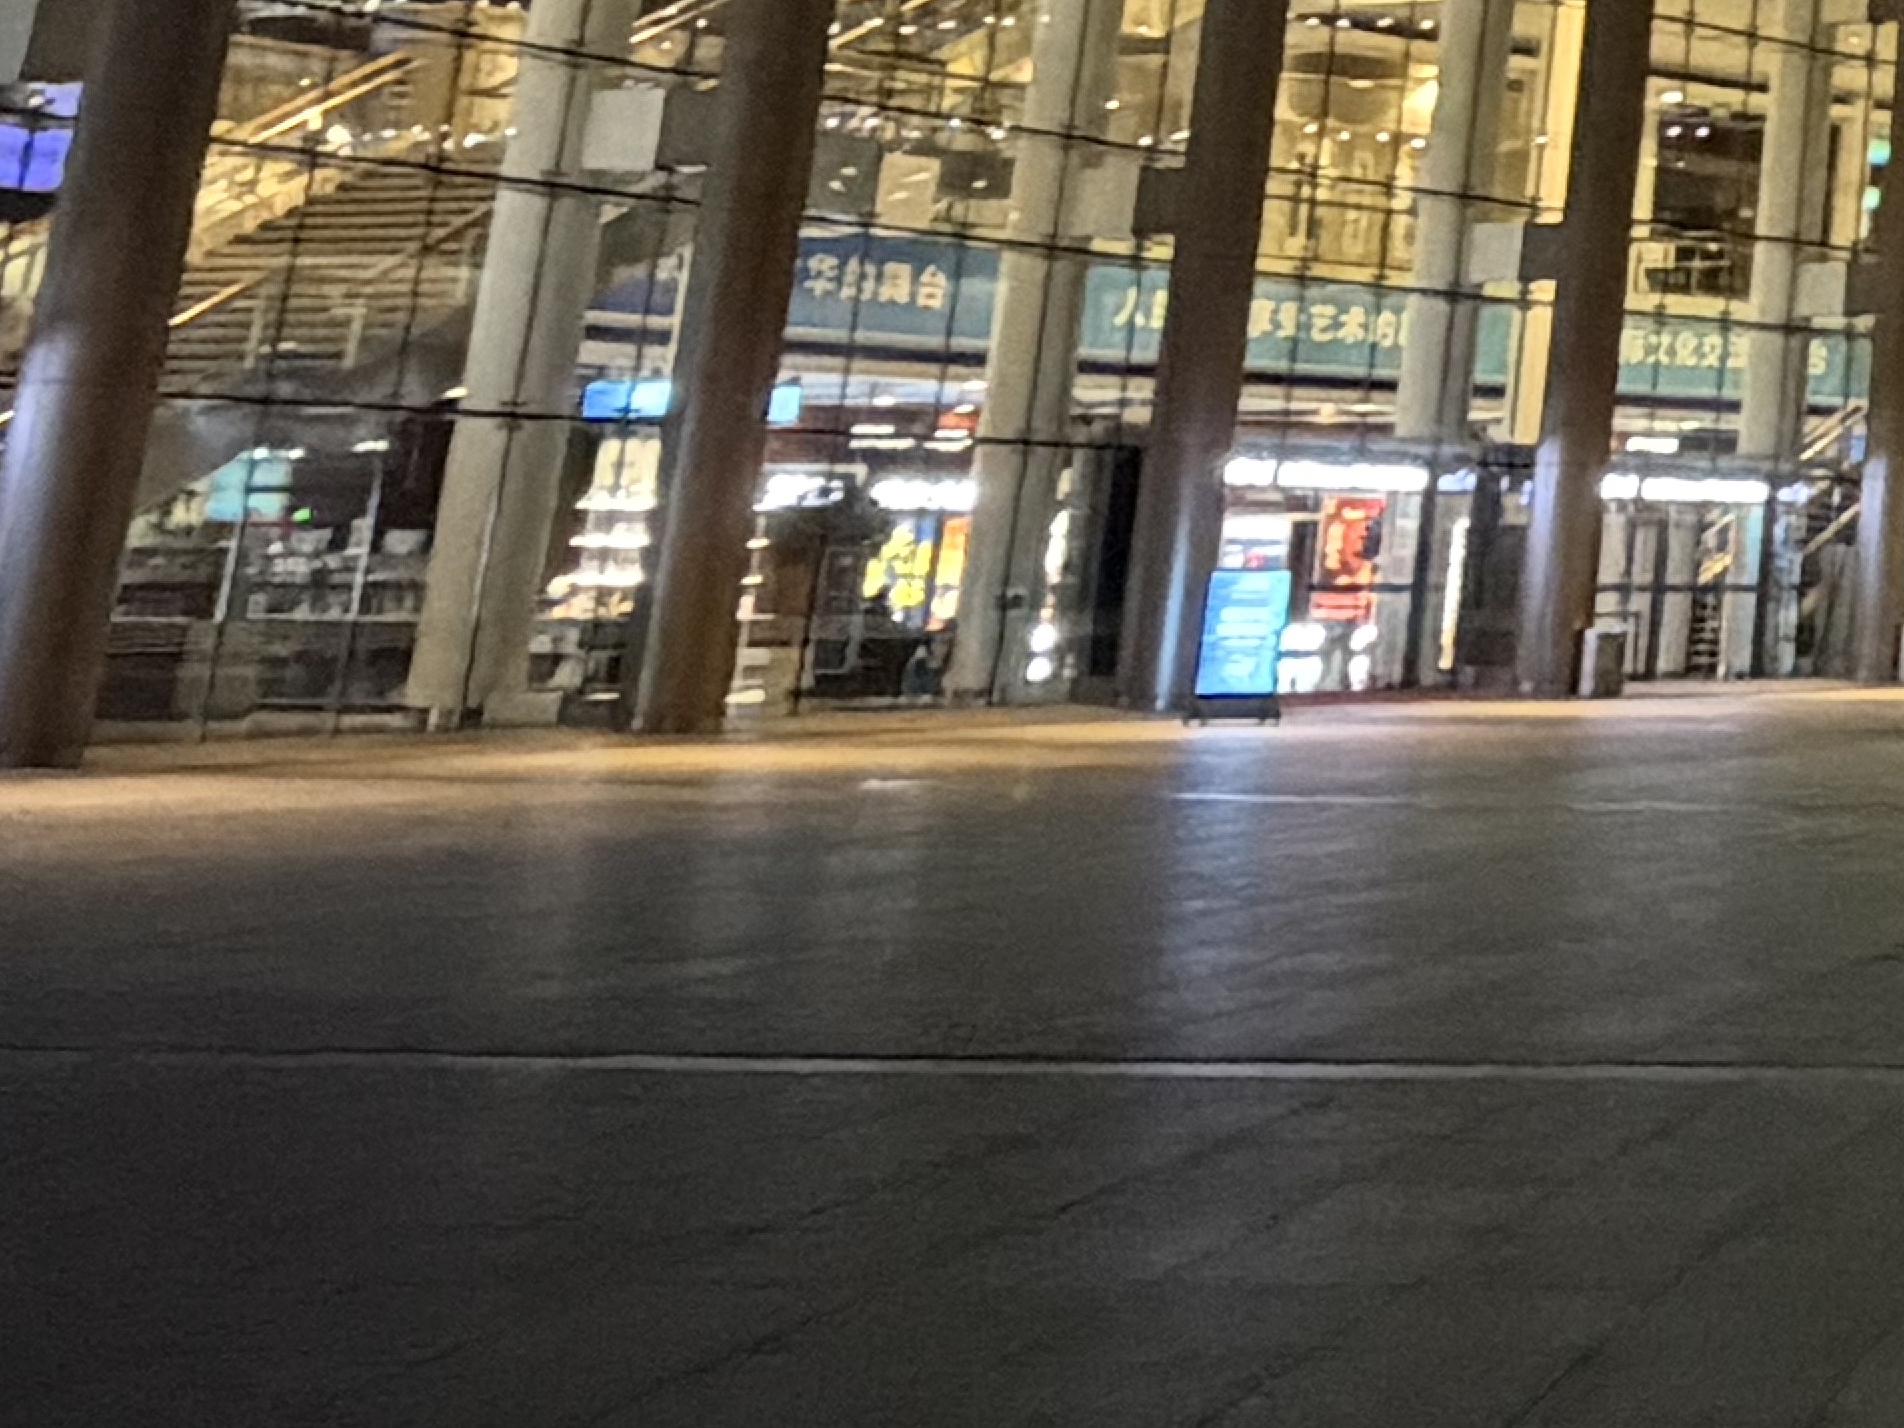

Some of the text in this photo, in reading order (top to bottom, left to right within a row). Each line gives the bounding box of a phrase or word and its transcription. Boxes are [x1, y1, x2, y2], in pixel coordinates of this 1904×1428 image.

[1247, 297, 1409, 348] 享受艺术的
